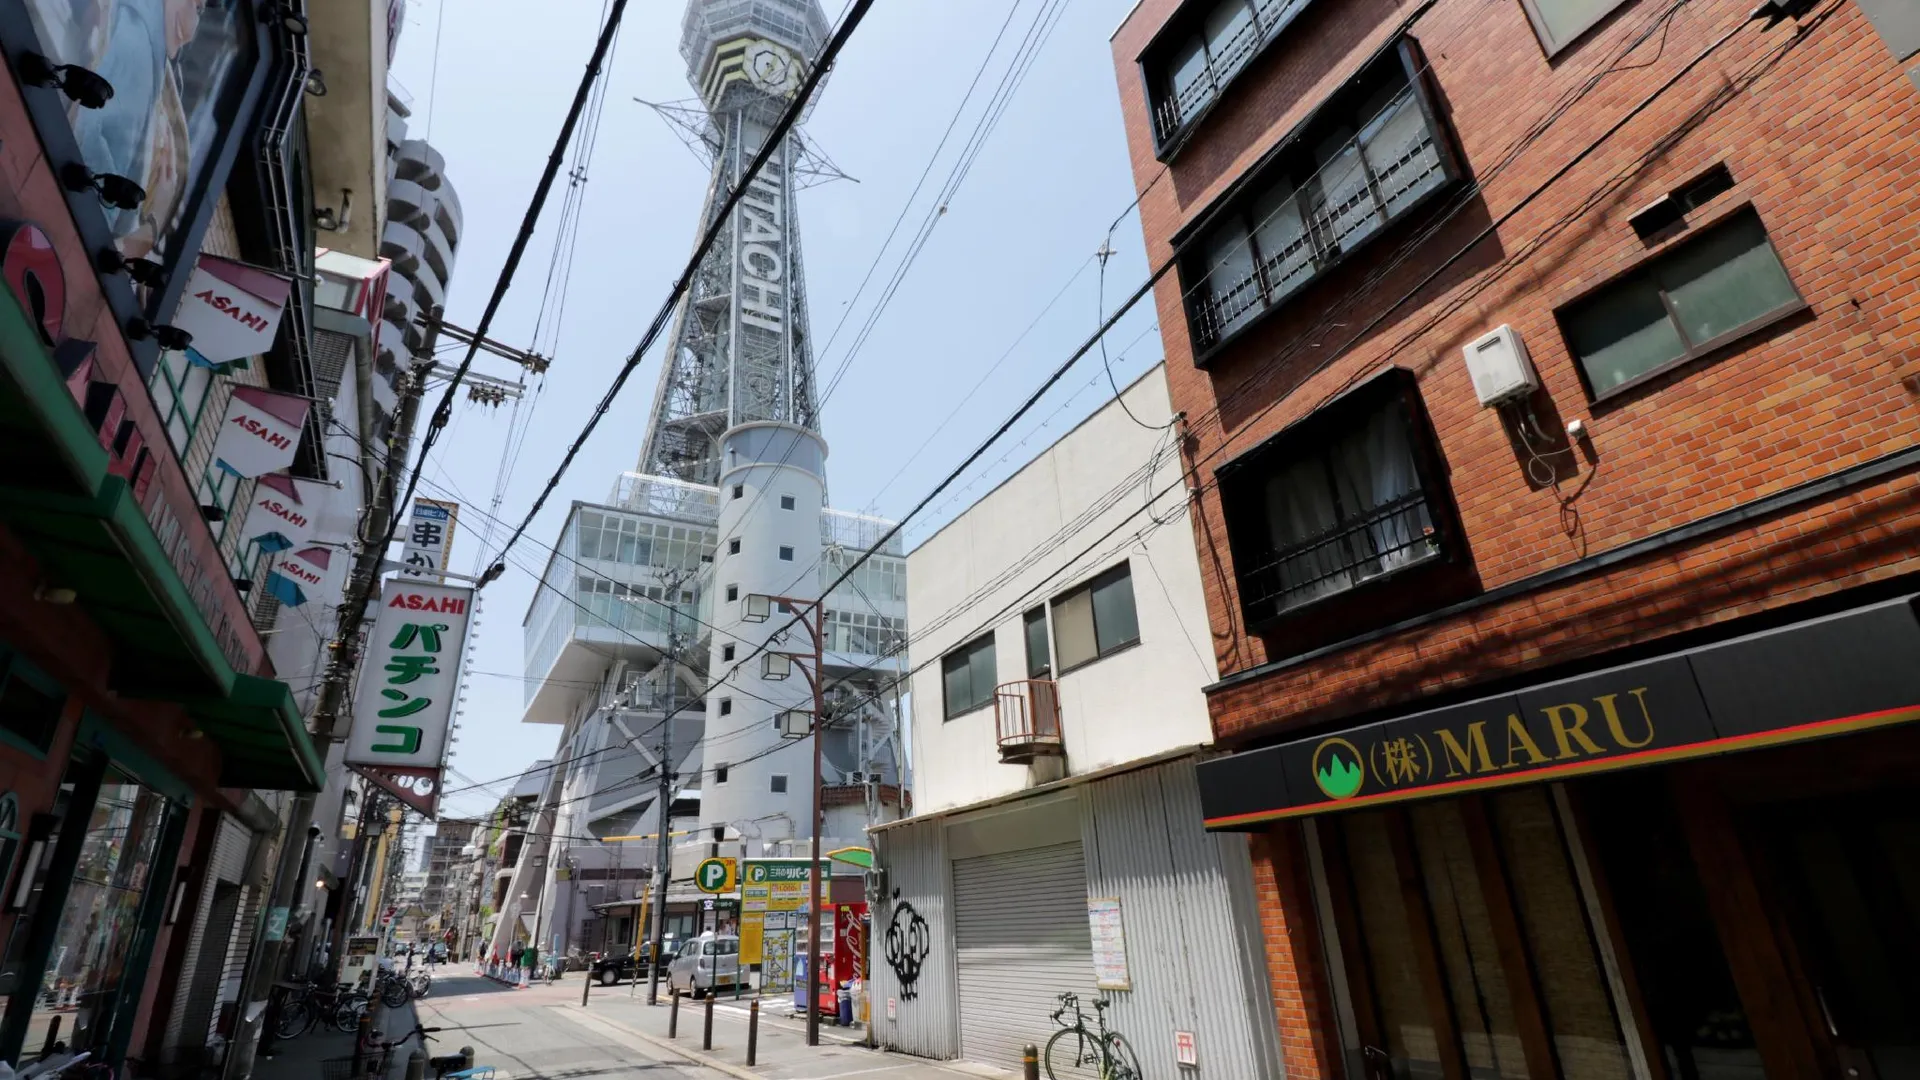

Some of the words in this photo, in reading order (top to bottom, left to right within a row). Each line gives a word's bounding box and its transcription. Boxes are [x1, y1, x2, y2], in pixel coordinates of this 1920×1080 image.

[741, 147, 783, 333] HITACHI
[194, 289, 270, 333] ASAHI
[231, 415, 292, 451] ASAHI
[258, 499, 308, 529] ASAHI
[278, 560, 322, 586] ASAHI
[388, 592, 466, 615] ASAHI
[371, 623, 450, 754] パチンコ
[1436, 688, 1655, 777] MARU
[706, 864, 724, 888] P
[754, 868, 764, 881] P
